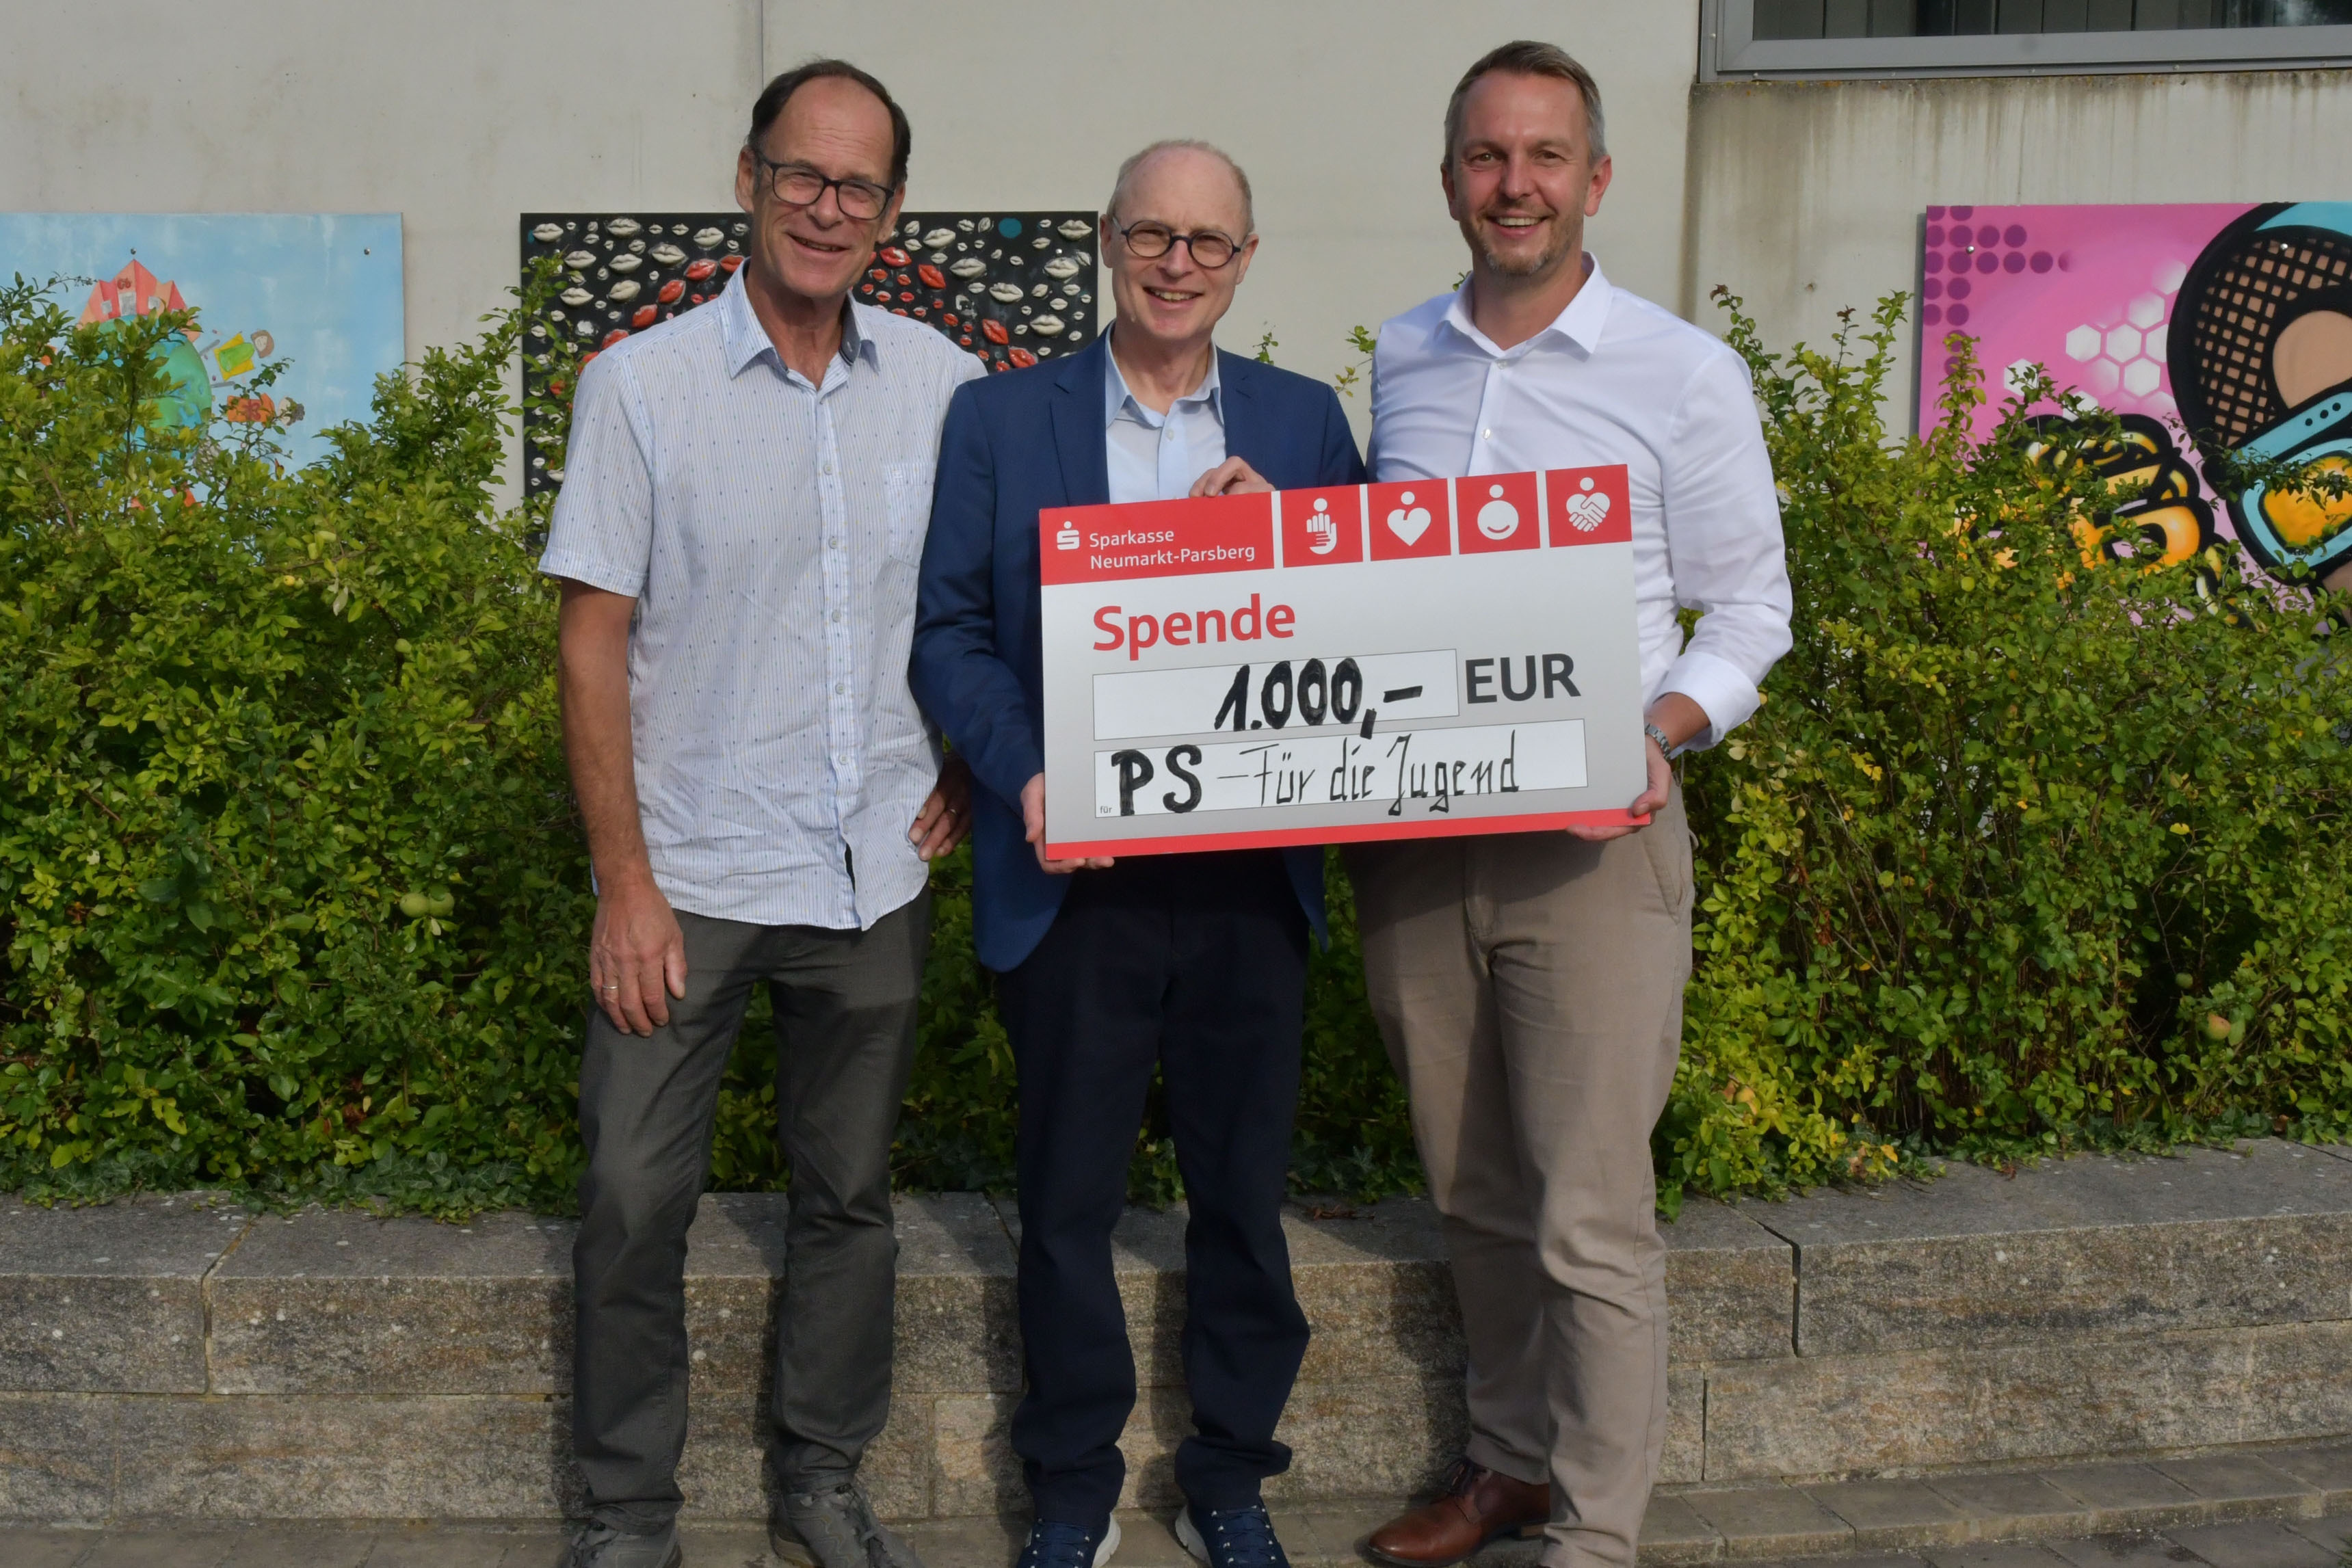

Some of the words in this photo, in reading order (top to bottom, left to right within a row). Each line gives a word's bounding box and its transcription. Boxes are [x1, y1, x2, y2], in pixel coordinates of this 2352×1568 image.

[1089, 531, 1174, 550] Sparkasse
[1091, 546, 1255, 570] Neumarkt-Parsberg
[1093, 594, 1296, 661] Spende
[1466, 654, 1581, 704] EUR
[1111, 744, 1202, 816] PS
[1330, 737, 1375, 801] die
[1386, 729, 1520, 816] Jugend
[1100, 806, 1113, 814] für
